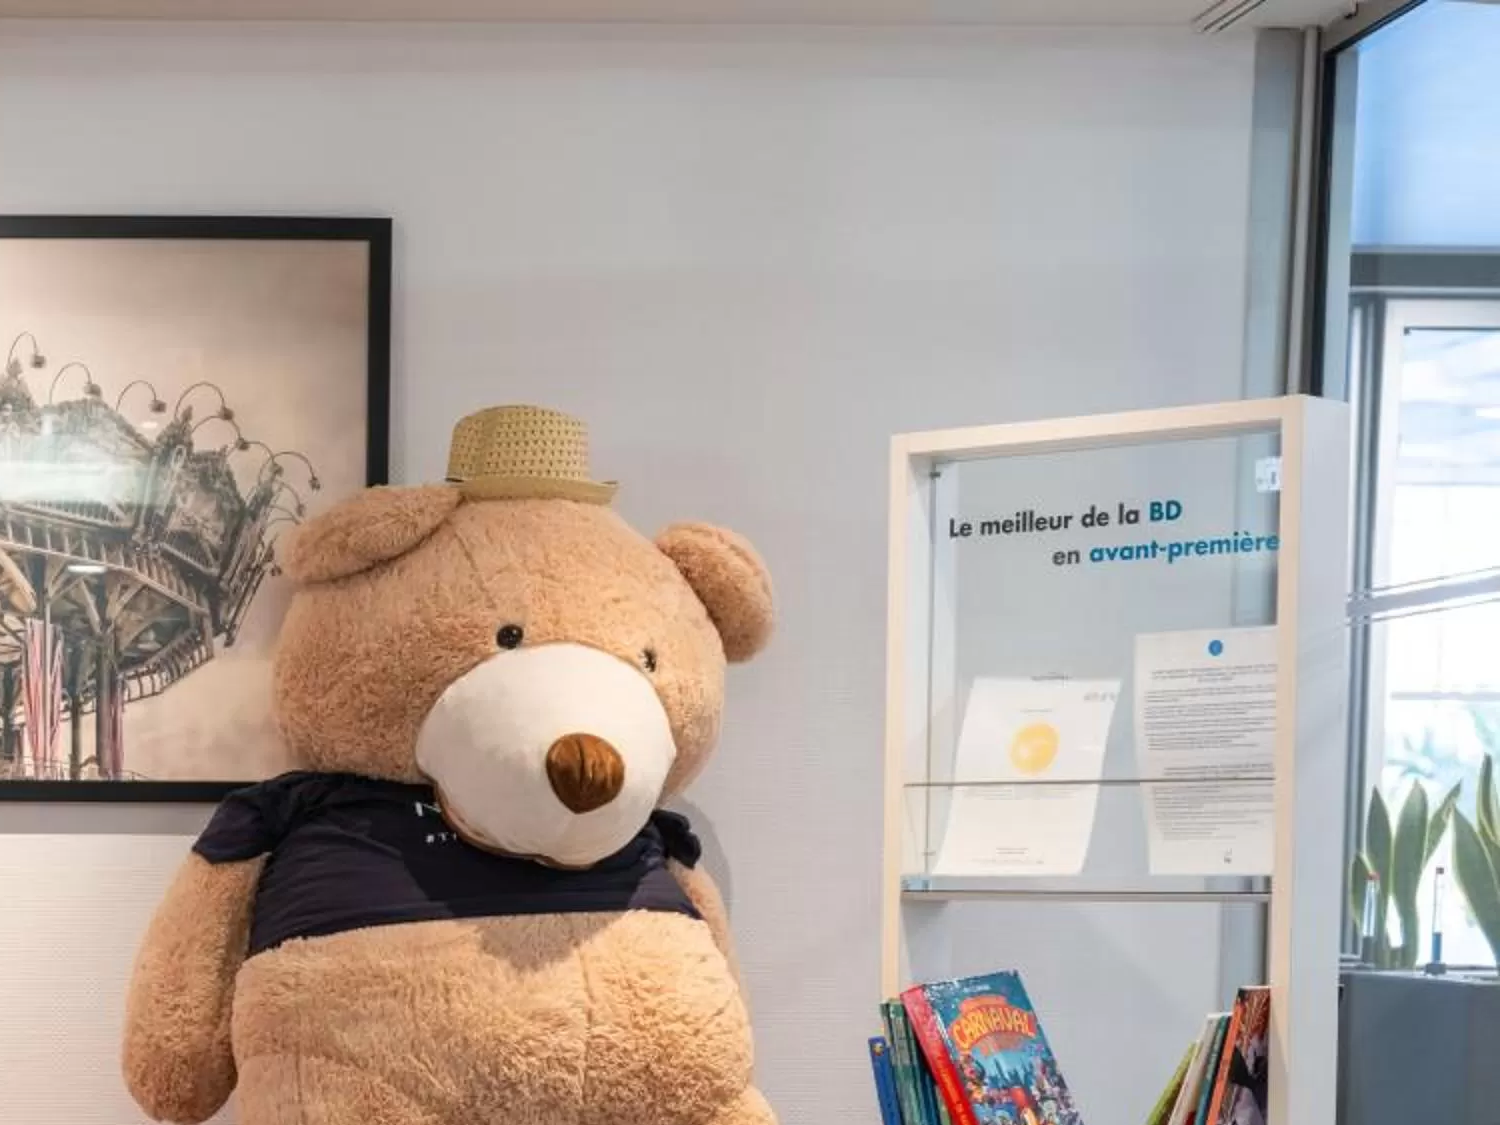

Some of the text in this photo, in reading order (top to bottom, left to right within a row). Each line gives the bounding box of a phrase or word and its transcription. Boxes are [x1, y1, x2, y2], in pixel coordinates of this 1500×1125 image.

[950, 500, 1182, 538] Le meilleur de la BD
[1052, 531, 1280, 566] en avant-première
